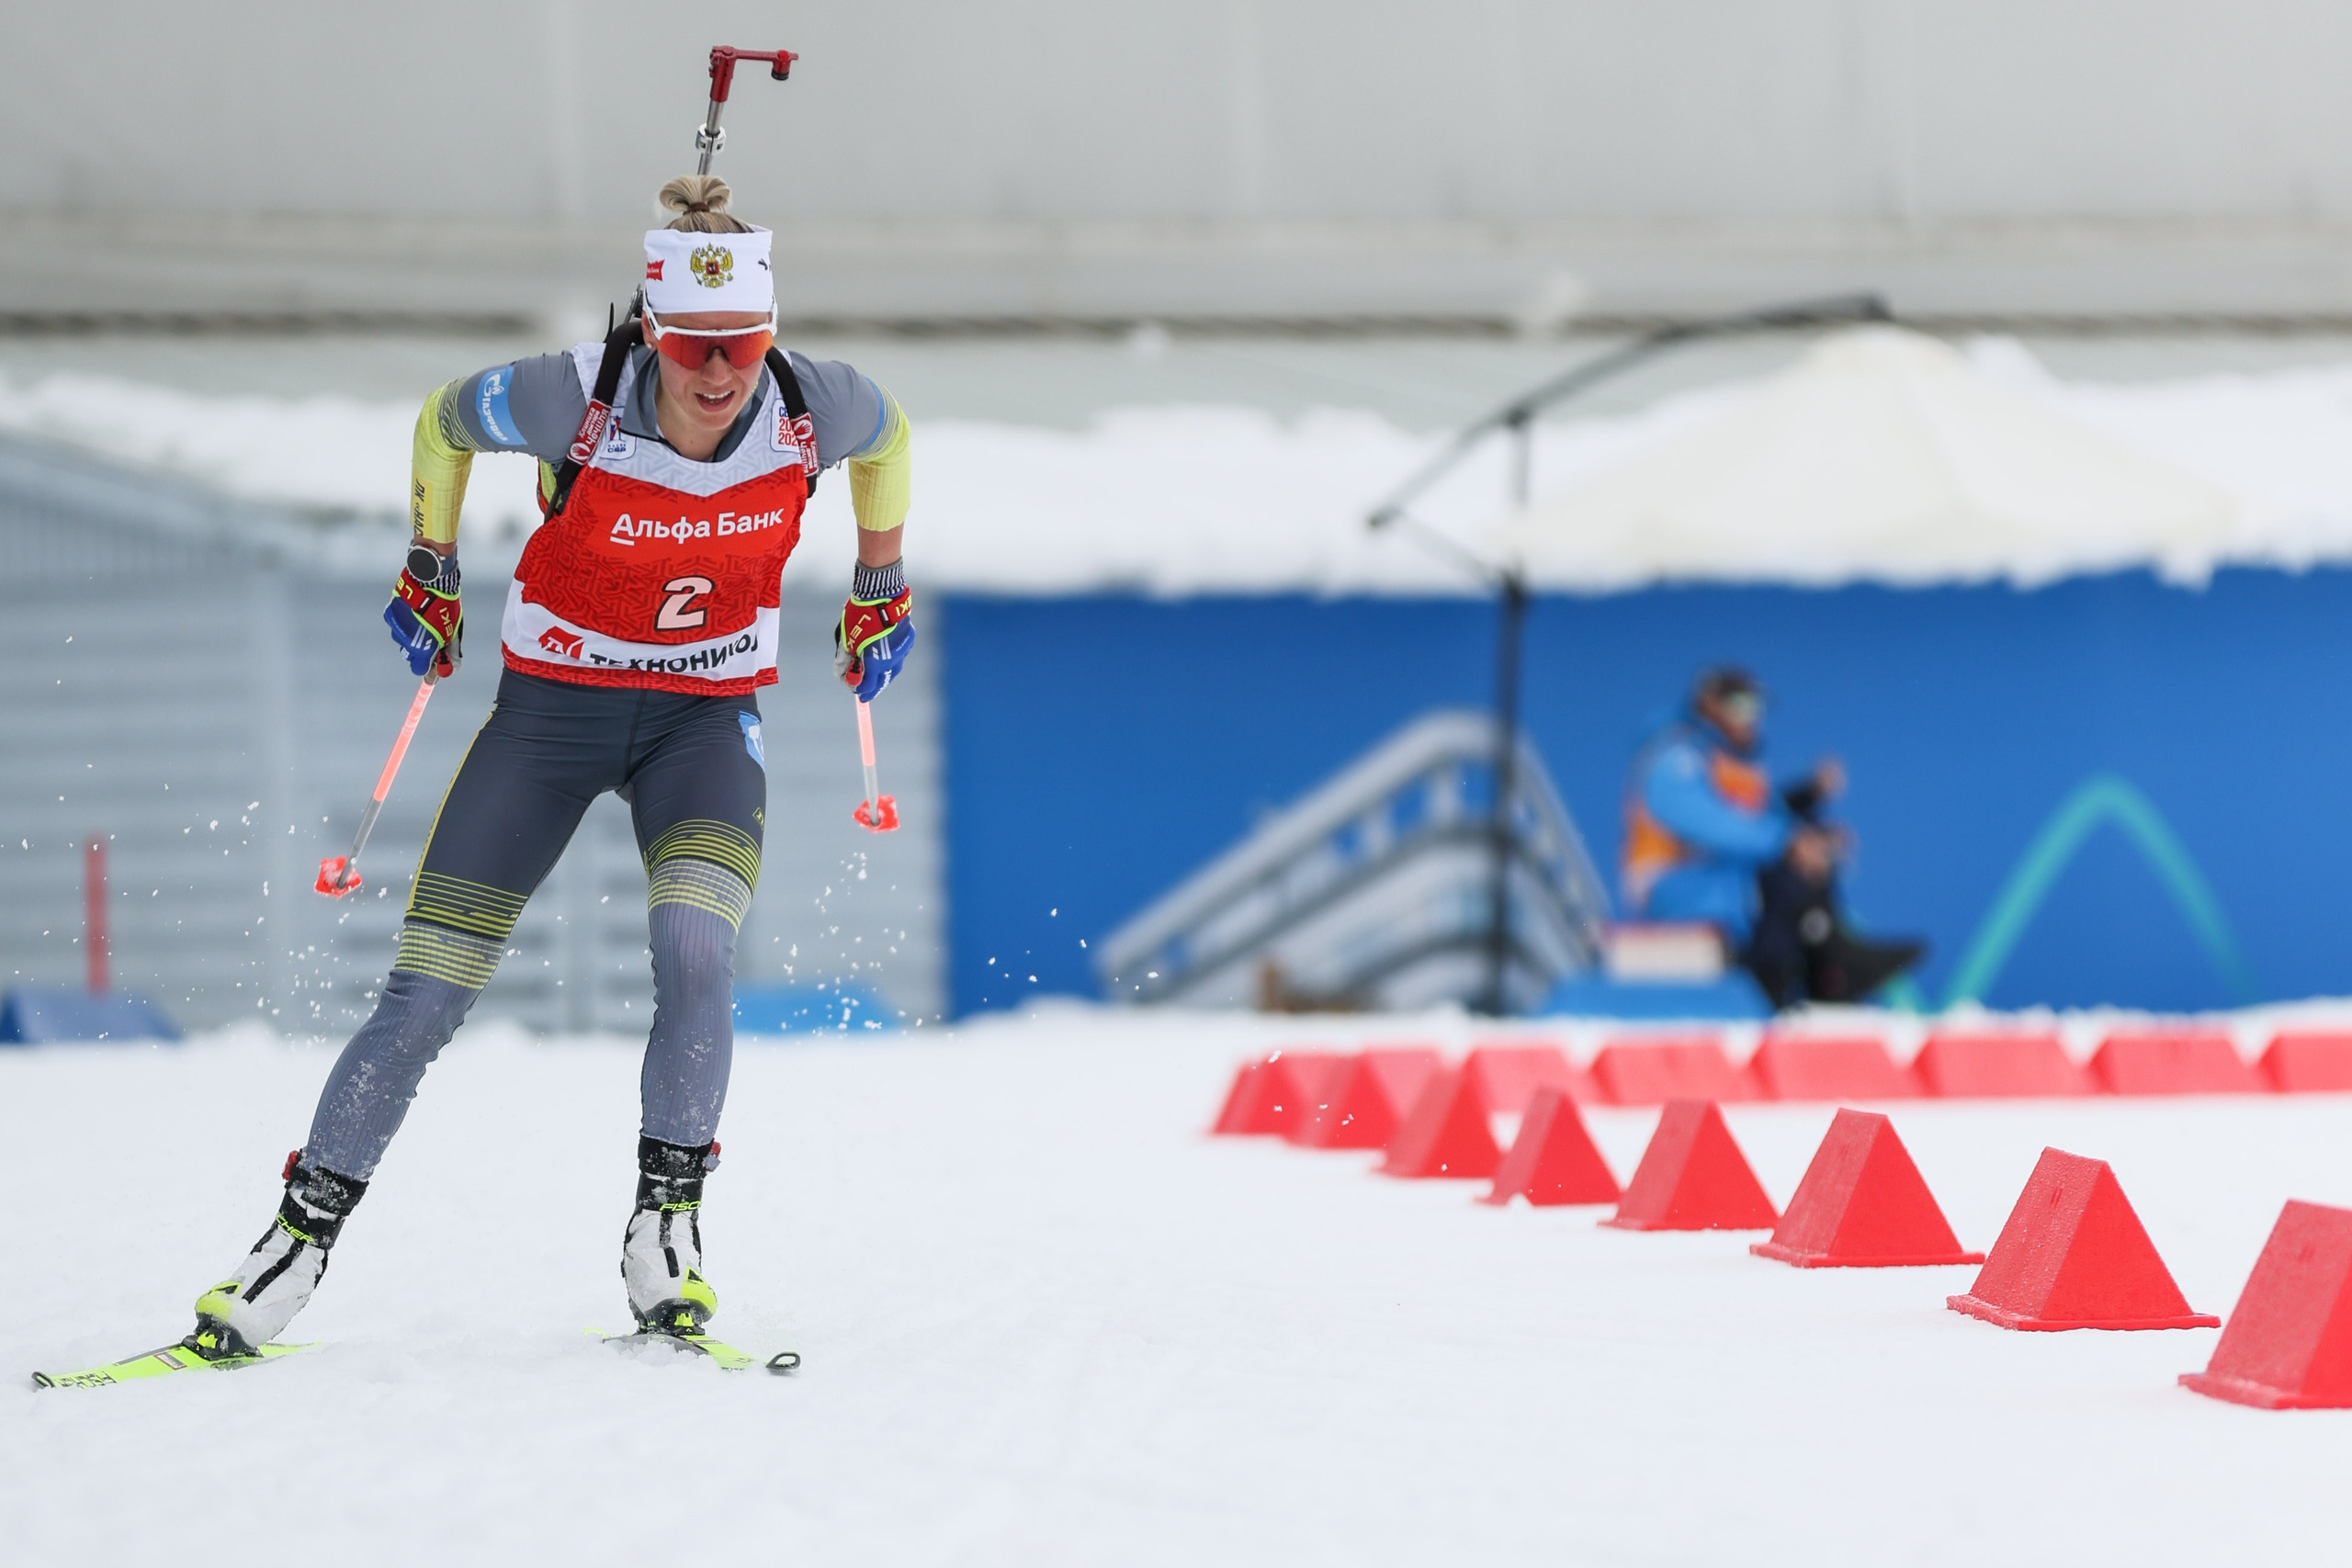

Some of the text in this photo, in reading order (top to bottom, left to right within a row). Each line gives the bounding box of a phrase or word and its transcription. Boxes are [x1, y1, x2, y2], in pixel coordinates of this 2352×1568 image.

[585, 408, 609, 445] Чечиля
[778, 432, 798, 446] 202
[779, 418, 792, 433] 20
[610, 508, 785, 546] Альфа Банк
[396, 576, 413, 600] LE
[654, 574, 716, 631] 2
[439, 606, 454, 637] EKI
[847, 614, 872, 651] LEK
[659, 1200, 702, 1212] FISC
[277, 1213, 314, 1244] CHER
